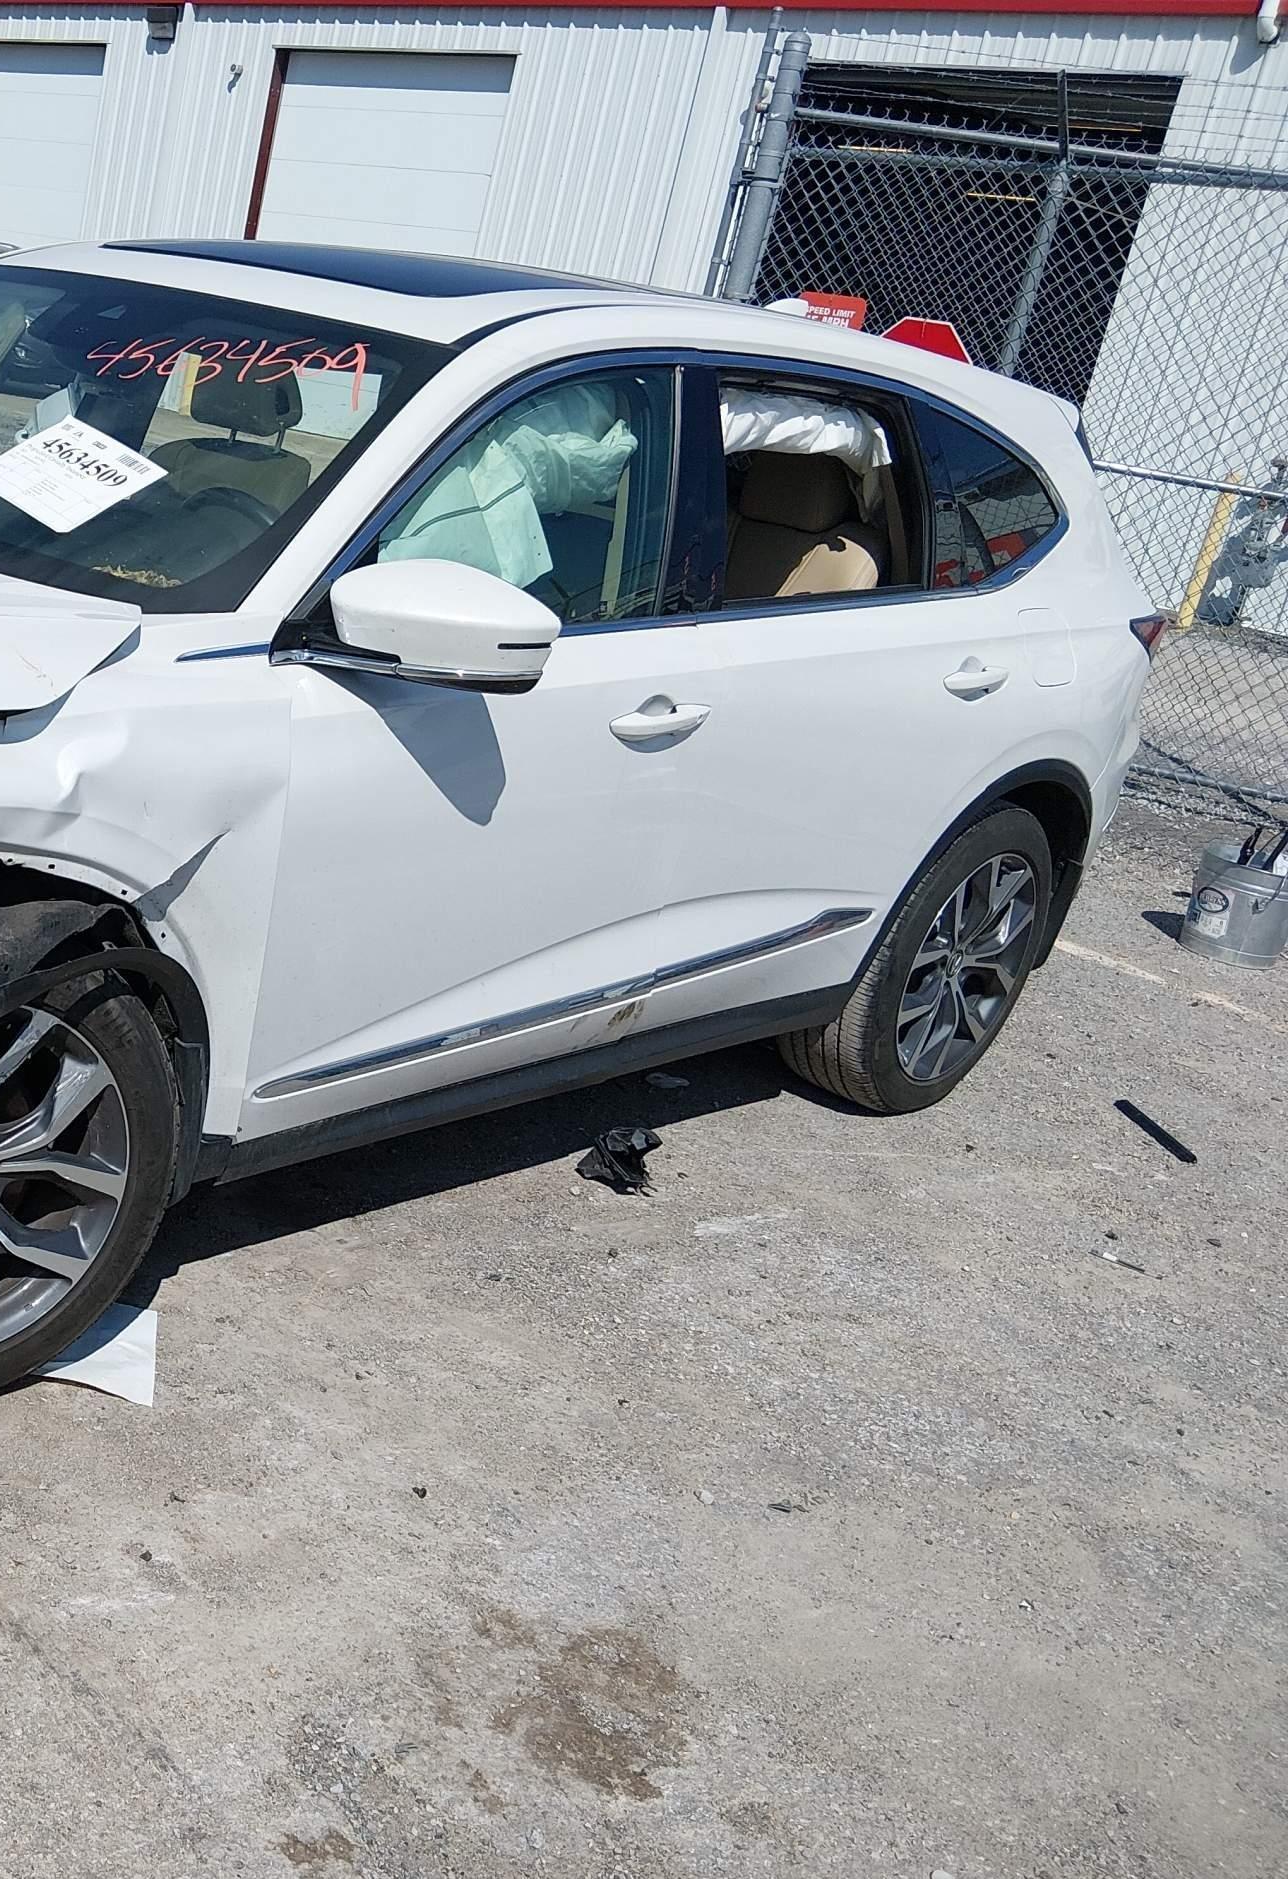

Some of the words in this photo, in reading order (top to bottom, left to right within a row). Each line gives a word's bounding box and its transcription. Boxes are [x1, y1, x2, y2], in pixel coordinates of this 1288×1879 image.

[807, 306, 830, 316] PEED
[832, 308, 857, 319] LIMIT
[85, 336, 373, 412] 45634509
[42, 438, 128, 487] 45634509
